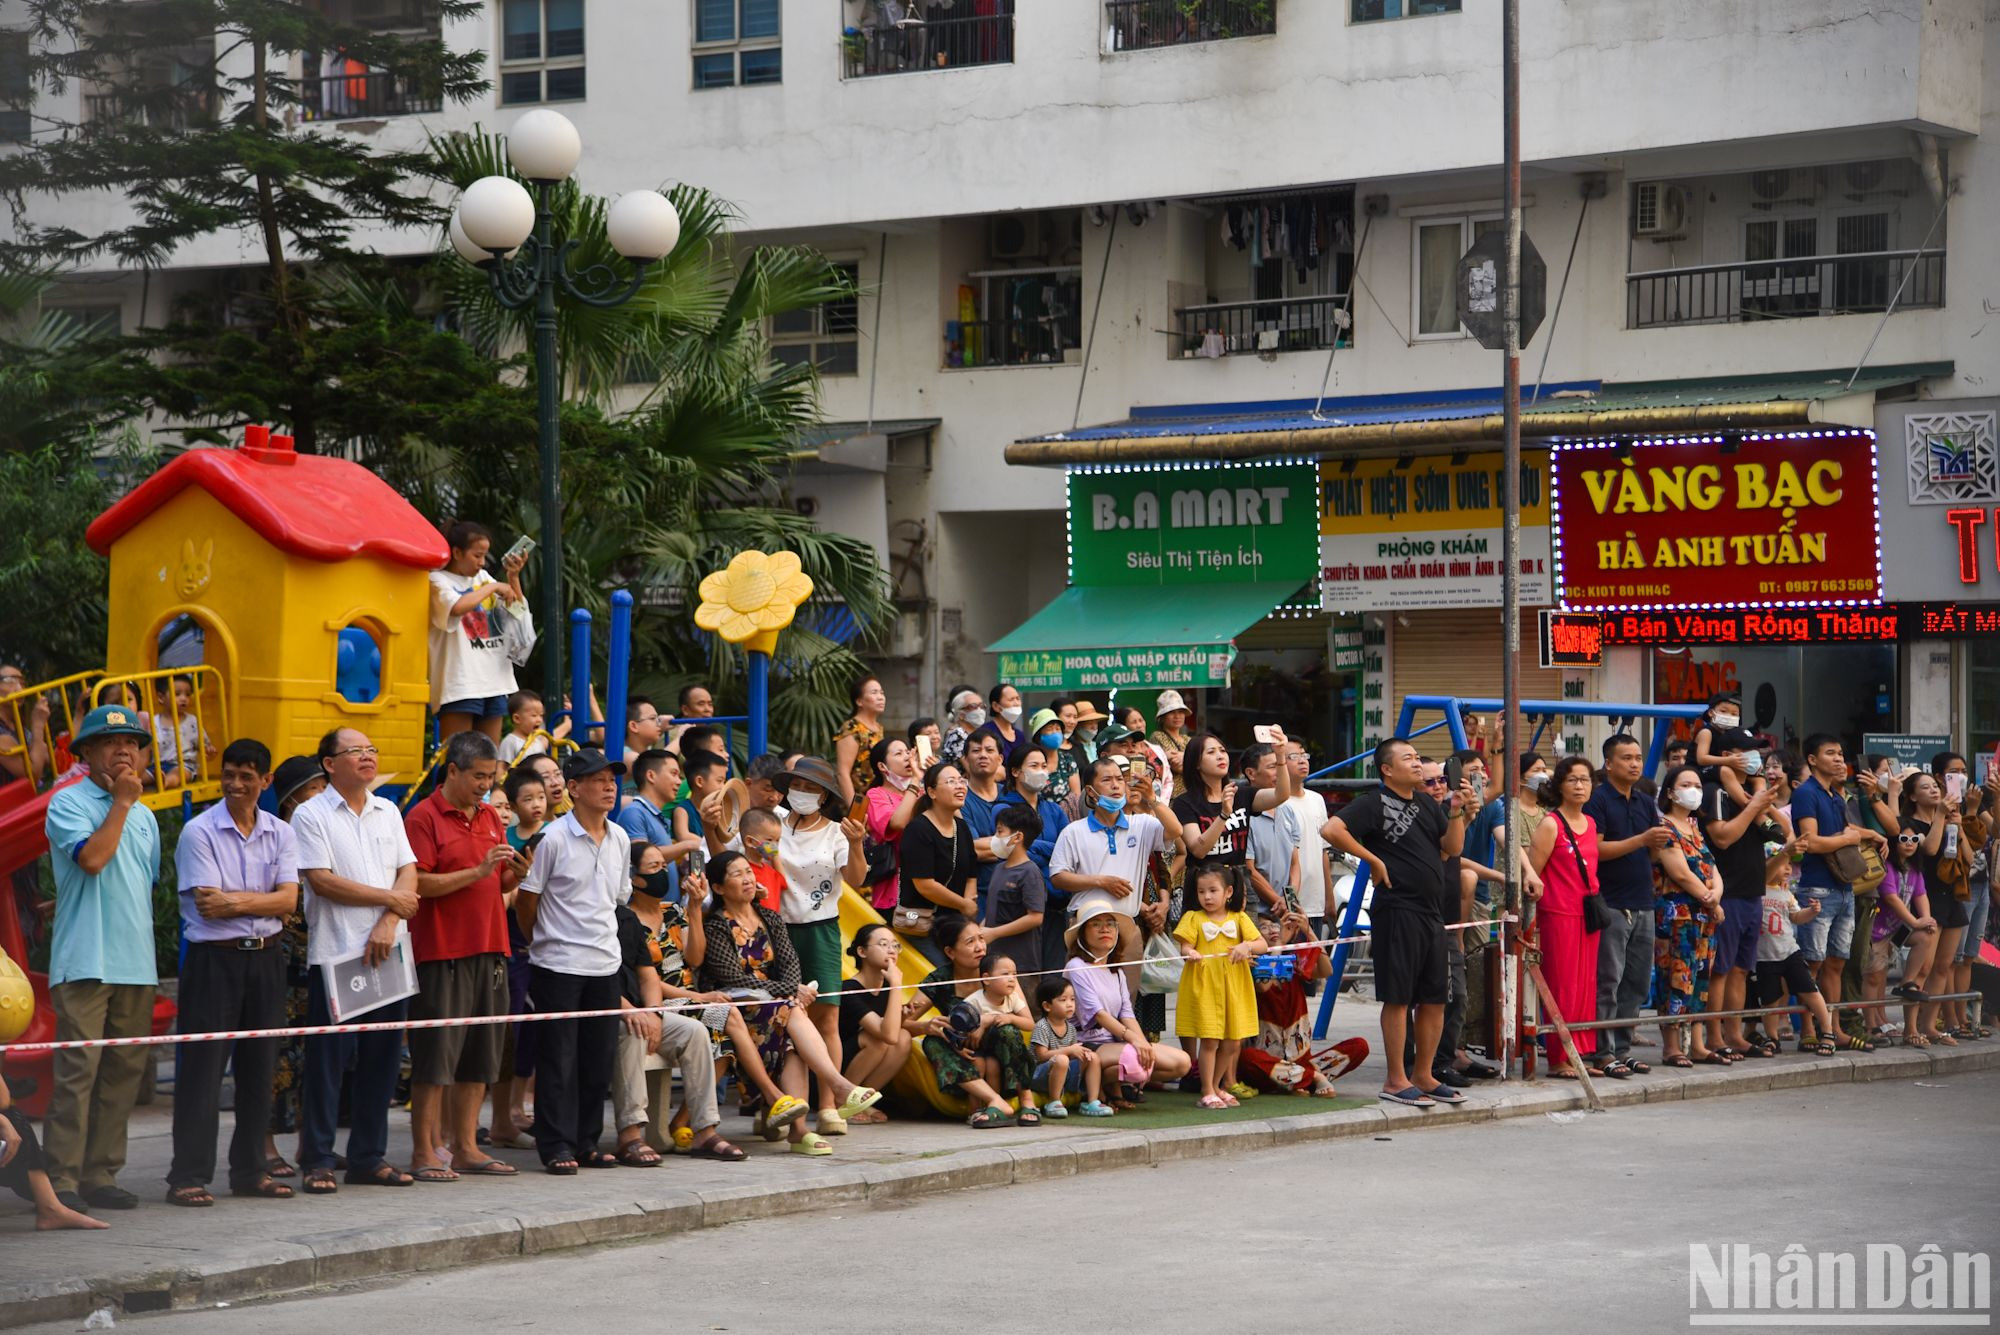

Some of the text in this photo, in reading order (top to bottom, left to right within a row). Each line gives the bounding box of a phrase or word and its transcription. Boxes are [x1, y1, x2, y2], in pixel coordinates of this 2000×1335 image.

[1370, 469, 1409, 521] HIỆN
[1414, 466, 1451, 513] SỚM
[1581, 456, 1843, 518] VÀNG BẠC
[1092, 487, 1290, 531] B.A MART
[1378, 533, 1488, 557] PHÒNG KHÁM
[1597, 518, 1827, 569] HÀ ANH TUẤN
[1126, 545, 1263, 571] Siêu Thị Tiện Ích
[1324, 563, 1360, 582] CHUYÊN
[1363, 564, 1388, 580] KHOA
[1391, 557, 1417, 580] CHẨN
[1420, 561, 1445, 578] ĐOÁN
[1449, 561, 1471, 577] HÌNH
[1475, 555, 1494, 576] ẢNH
[1537, 558, 1544, 575] K
[1587, 585, 1616, 597] KIOT
[1619, 584, 1635, 596] 80
[1637, 583, 1671, 596] HH4C
[1785, 579, 1818, 592] 0987
[1821, 578, 1847, 592] 663
[1848, 578, 1874, 591] 569
[1623, 615, 1667, 637] Bán
[1674, 612, 1736, 643] Vàng
[1744, 607, 1809, 641] Rồng
[1817, 610, 1897, 638] Thăng
[1553, 617, 1599, 661] VÀNG BẠC
[1065, 646, 1206, 669] HOA QUẢ NHẬP KHẨU
[1336, 650, 1364, 665] DOCTOR K
[1081, 672, 1109, 685] HOA
[1112, 668, 1140, 684] QUẢ
[1144, 670, 1153, 683] 3
[1157, 666, 1192, 682] MIỀN
[1565, 677, 1585, 698] SOÁT
[1365, 679, 1383, 699] SOÁT
[1365, 707, 1383, 726] PHÁT
[1385, 802, 1420, 843] adidas
